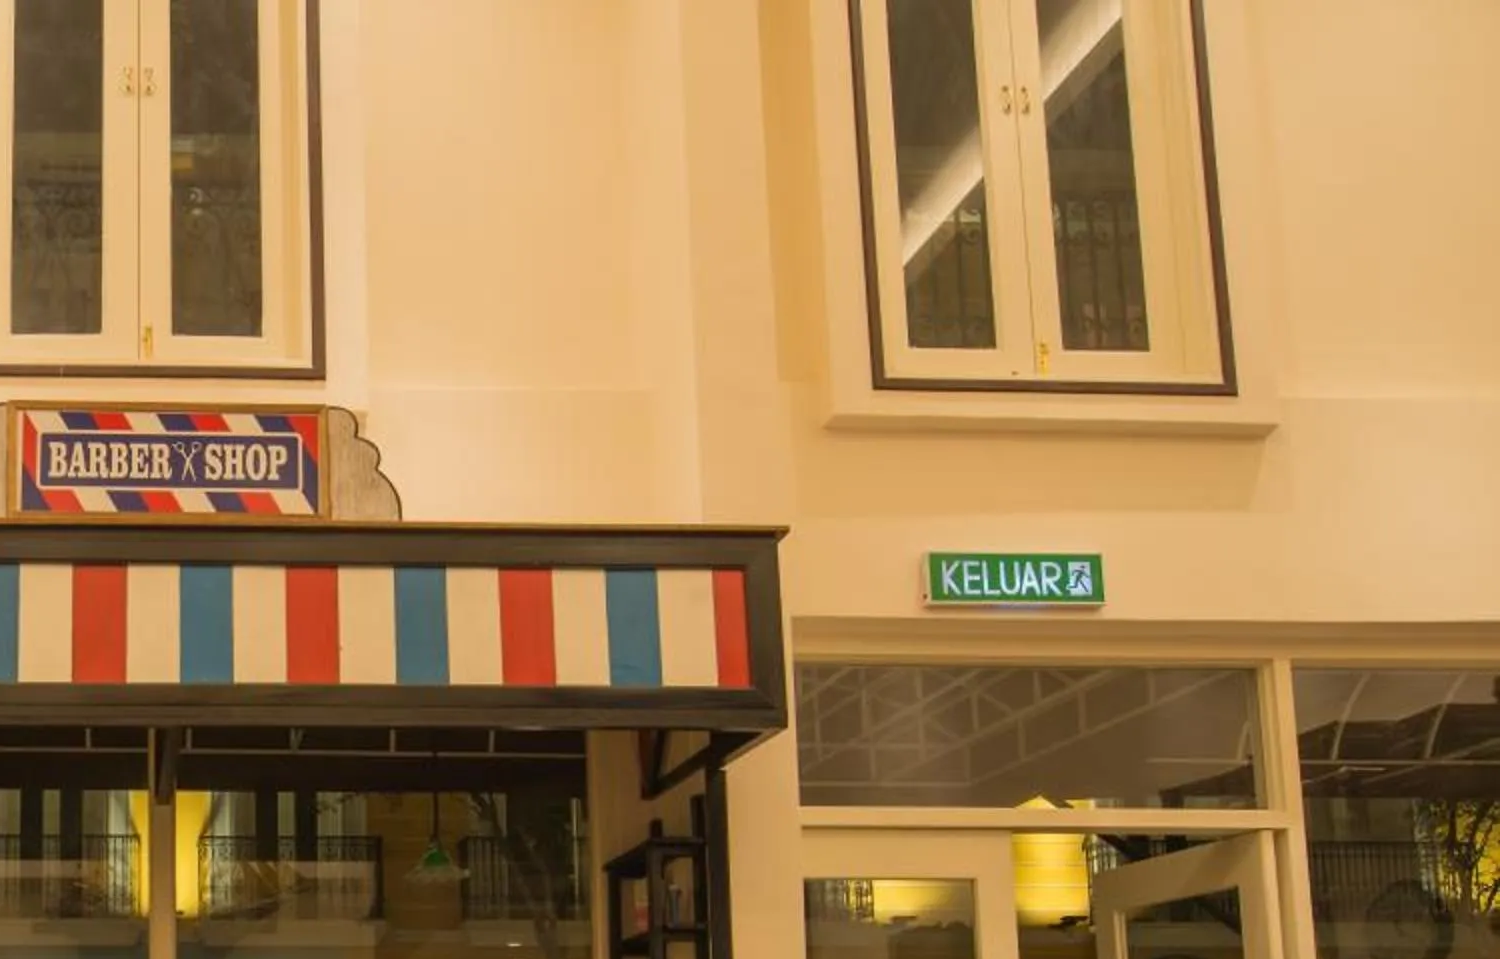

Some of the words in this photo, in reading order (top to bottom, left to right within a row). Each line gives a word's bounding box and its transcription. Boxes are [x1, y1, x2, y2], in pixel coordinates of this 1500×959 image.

[48, 441, 172, 479] BARBER
[205, 444, 287, 481] SHOP
[941, 560, 1063, 596] KELUAR
